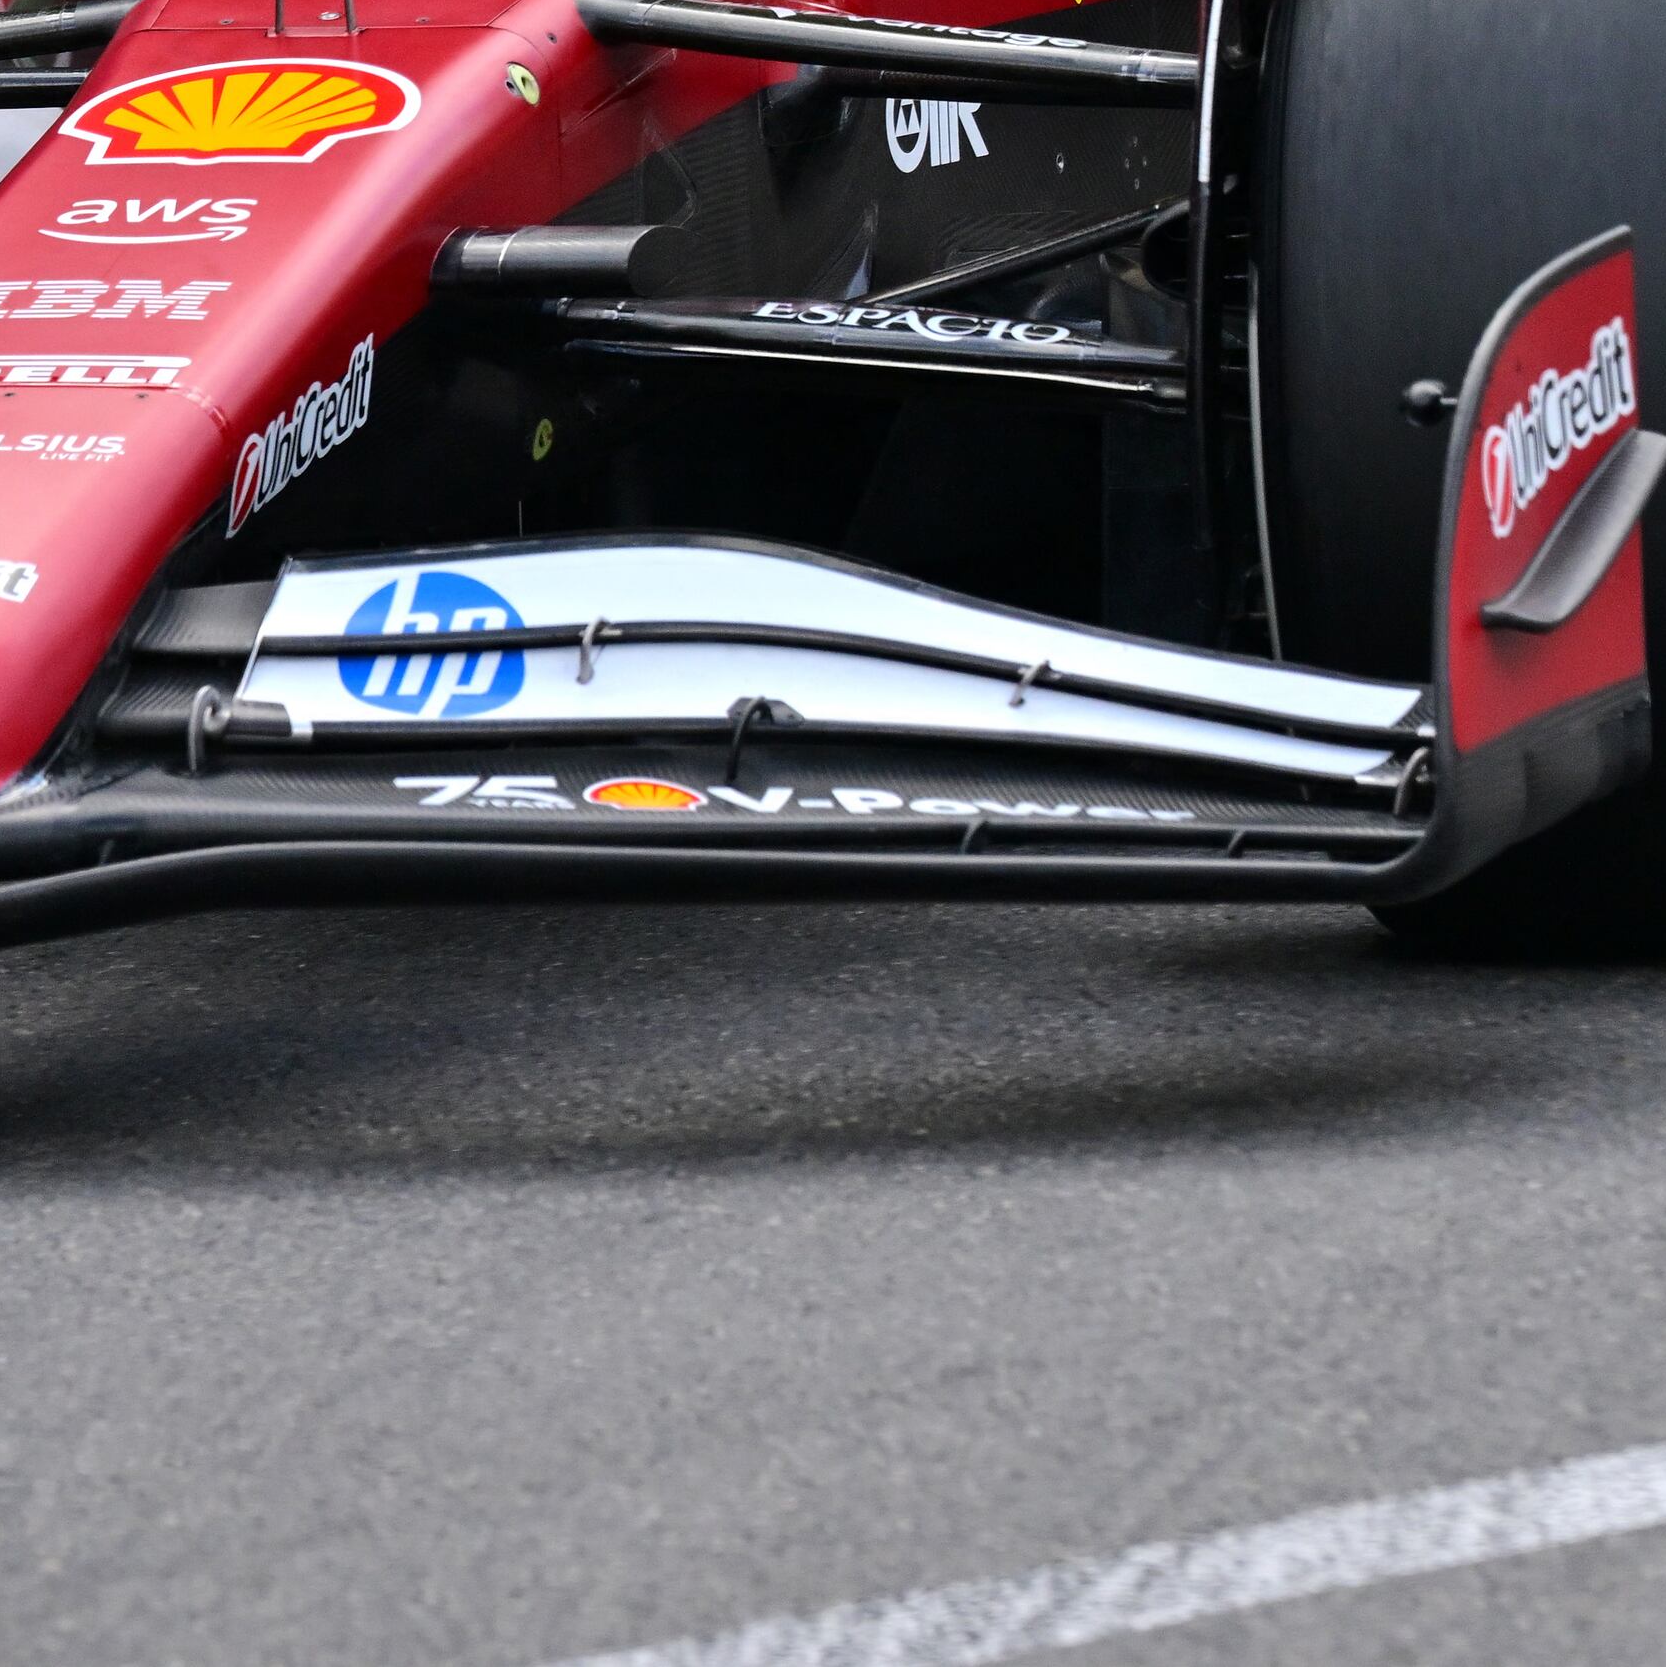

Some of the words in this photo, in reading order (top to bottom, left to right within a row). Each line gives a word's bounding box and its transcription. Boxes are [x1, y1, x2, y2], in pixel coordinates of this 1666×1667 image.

[56, 197, 259, 226] aws
[39, 451, 82, 462] LIVE
[84, 452, 115, 463] FIT
[255, 335, 373, 511] UniCredit
[1508, 319, 1634, 507] UniCredit
[360, 571, 511, 717] hp
[705, 785, 1196, 822] V-Power
